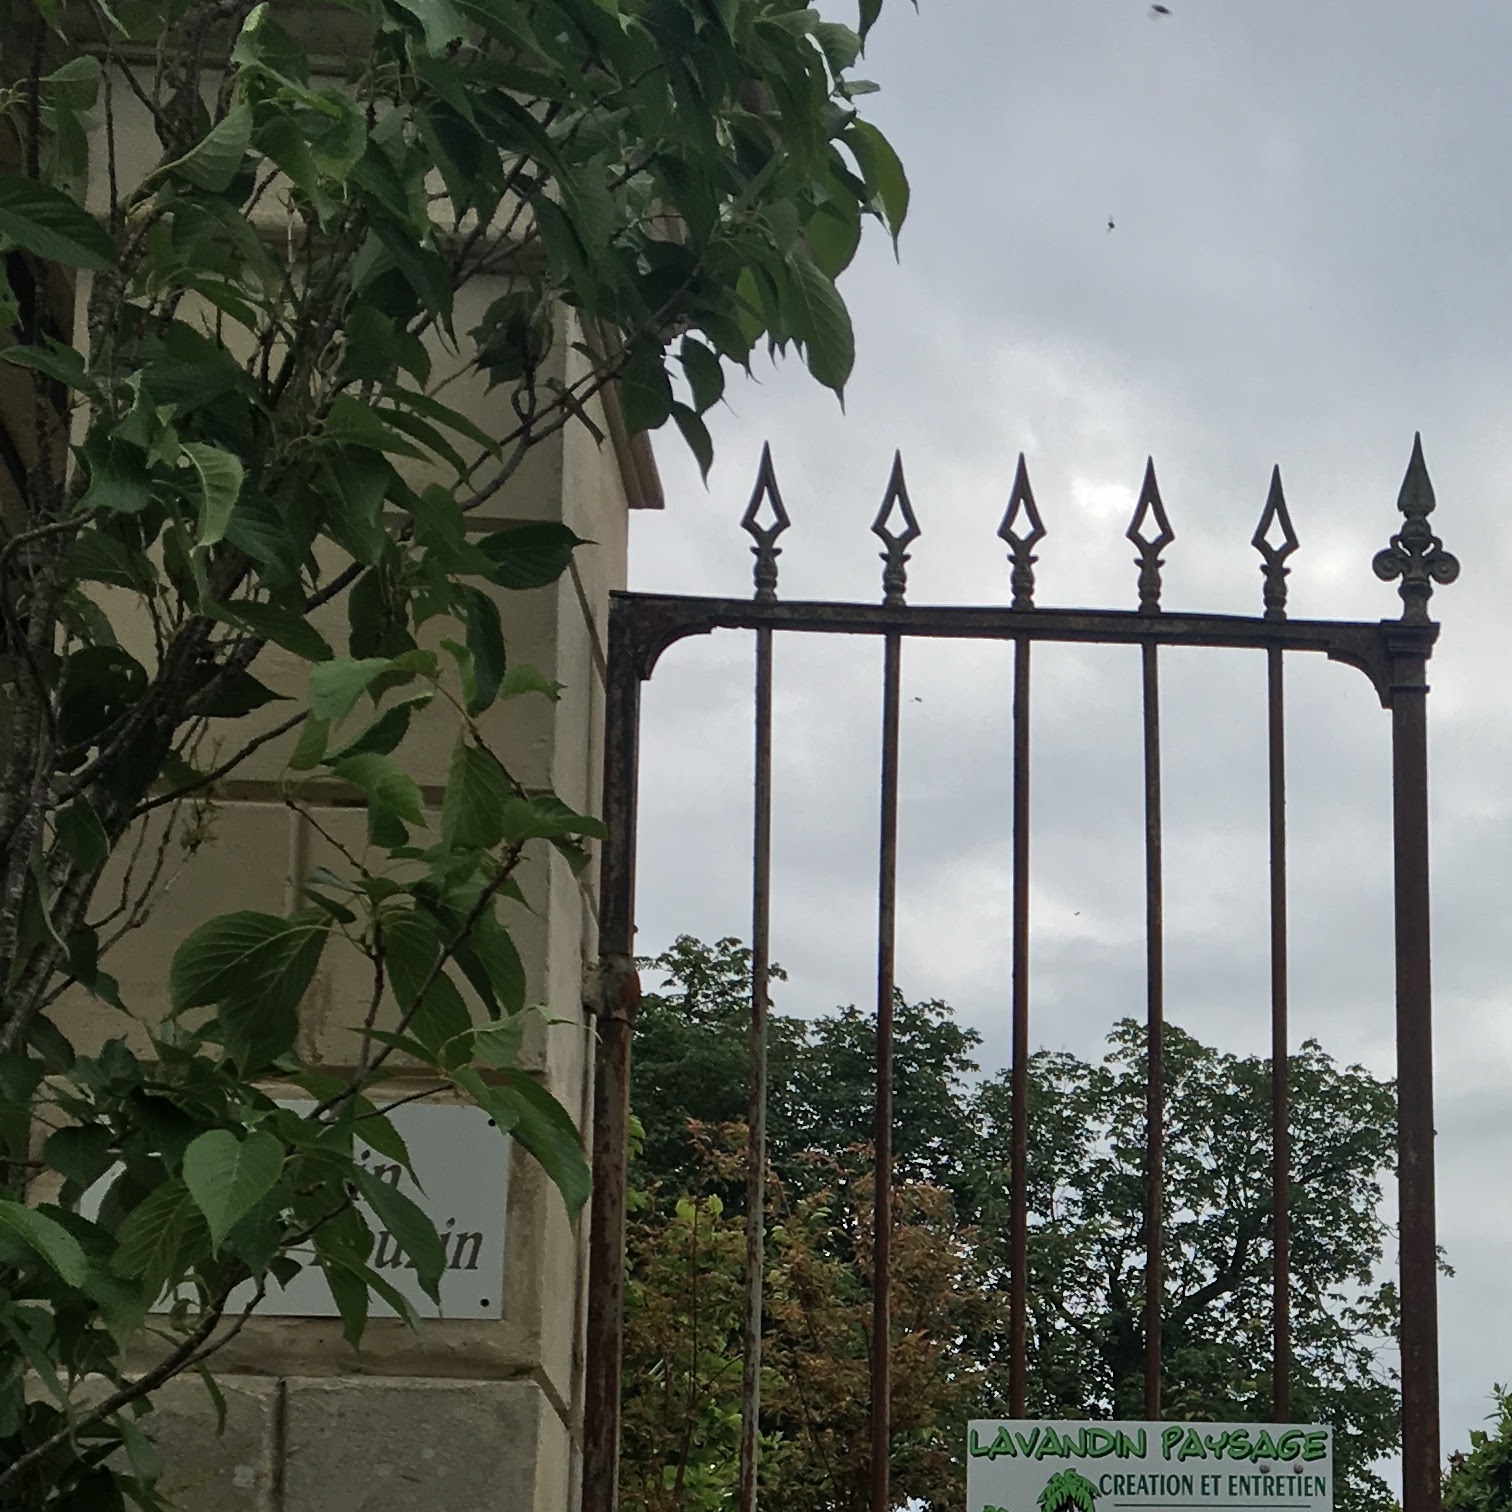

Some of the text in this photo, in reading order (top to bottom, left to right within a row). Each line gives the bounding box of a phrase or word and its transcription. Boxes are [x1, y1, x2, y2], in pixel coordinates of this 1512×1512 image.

[970, 1426, 1327, 1462] LAVANDIN PAYSAGE
[1099, 1474, 1326, 1497] CREATION ET ENTRETIEN
